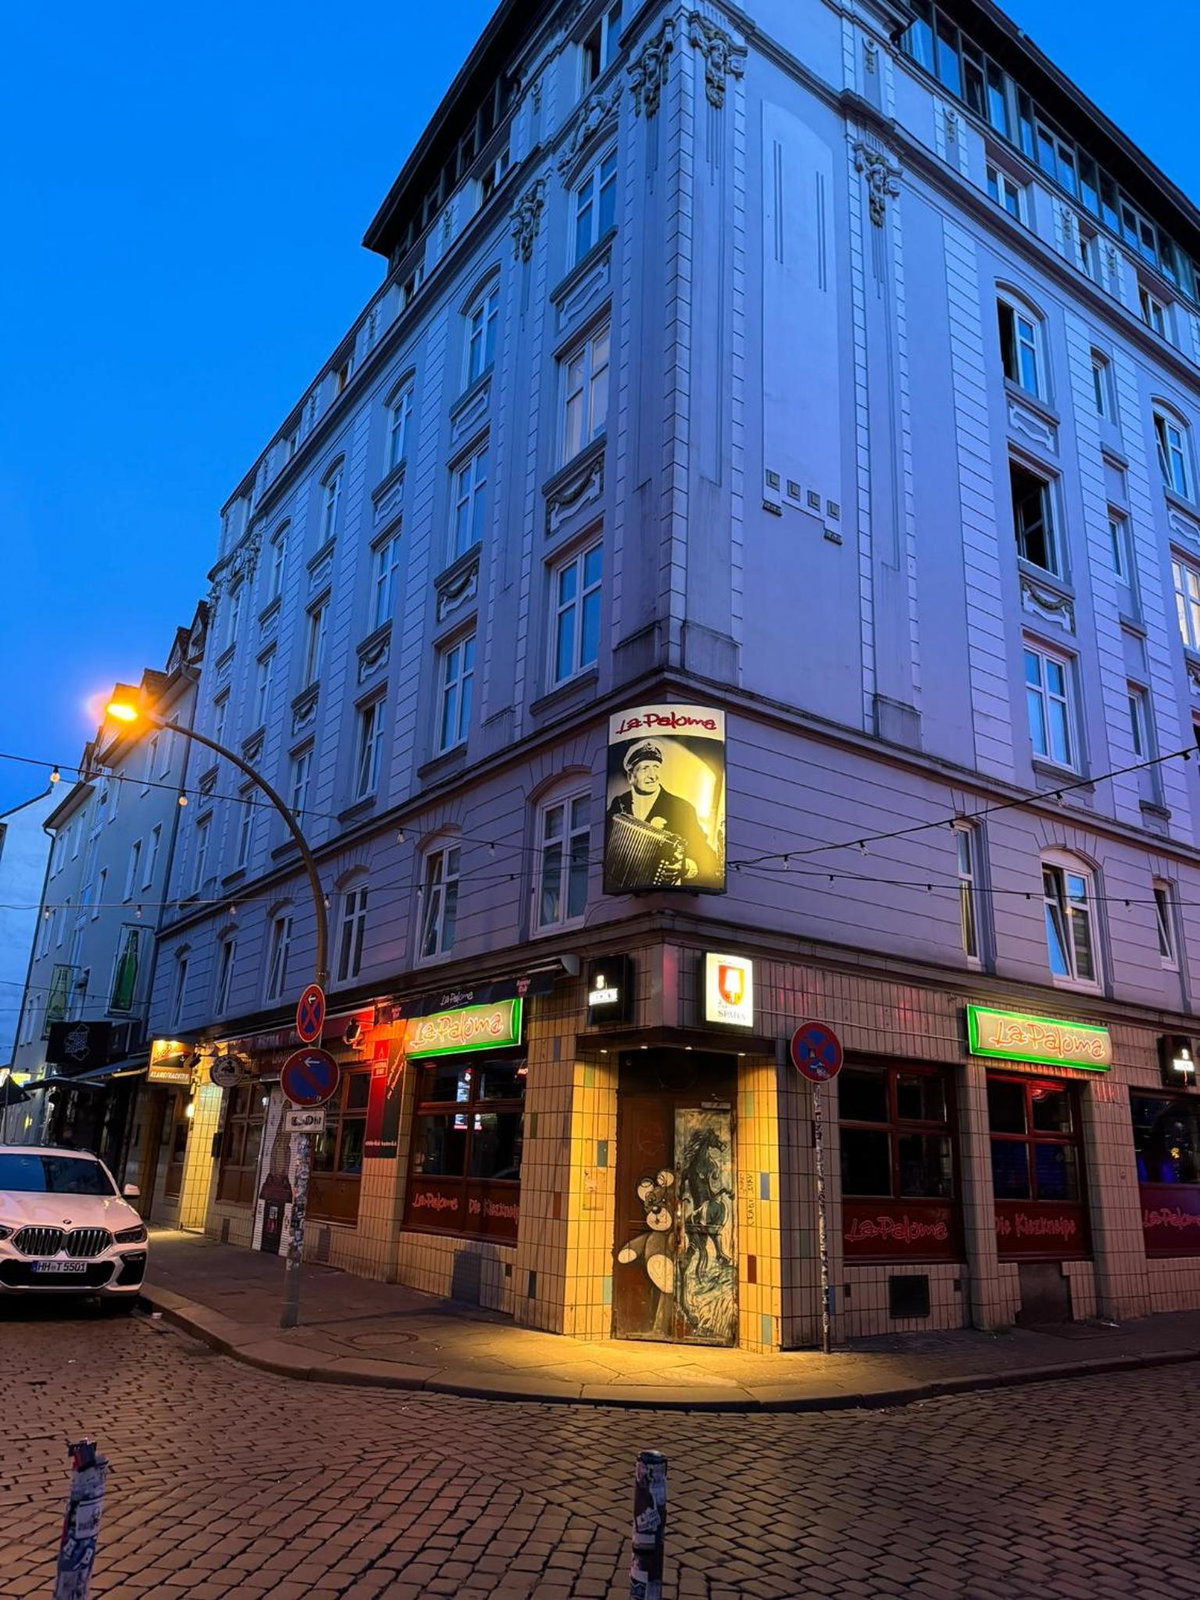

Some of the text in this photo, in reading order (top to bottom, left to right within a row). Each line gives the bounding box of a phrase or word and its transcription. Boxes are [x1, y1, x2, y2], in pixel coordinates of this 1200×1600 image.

[615, 711, 717, 735] La Paloma
[410, 1022, 439, 1049] La
[437, 1011, 504, 1046] Paloma
[989, 1020, 1106, 1059] La Paloma
[425, 1192, 458, 1212] Paloma
[468, 1198, 481, 1214] Die
[844, 1215, 949, 1243] La Paloma
[38, 1262, 51, 1272] HH
